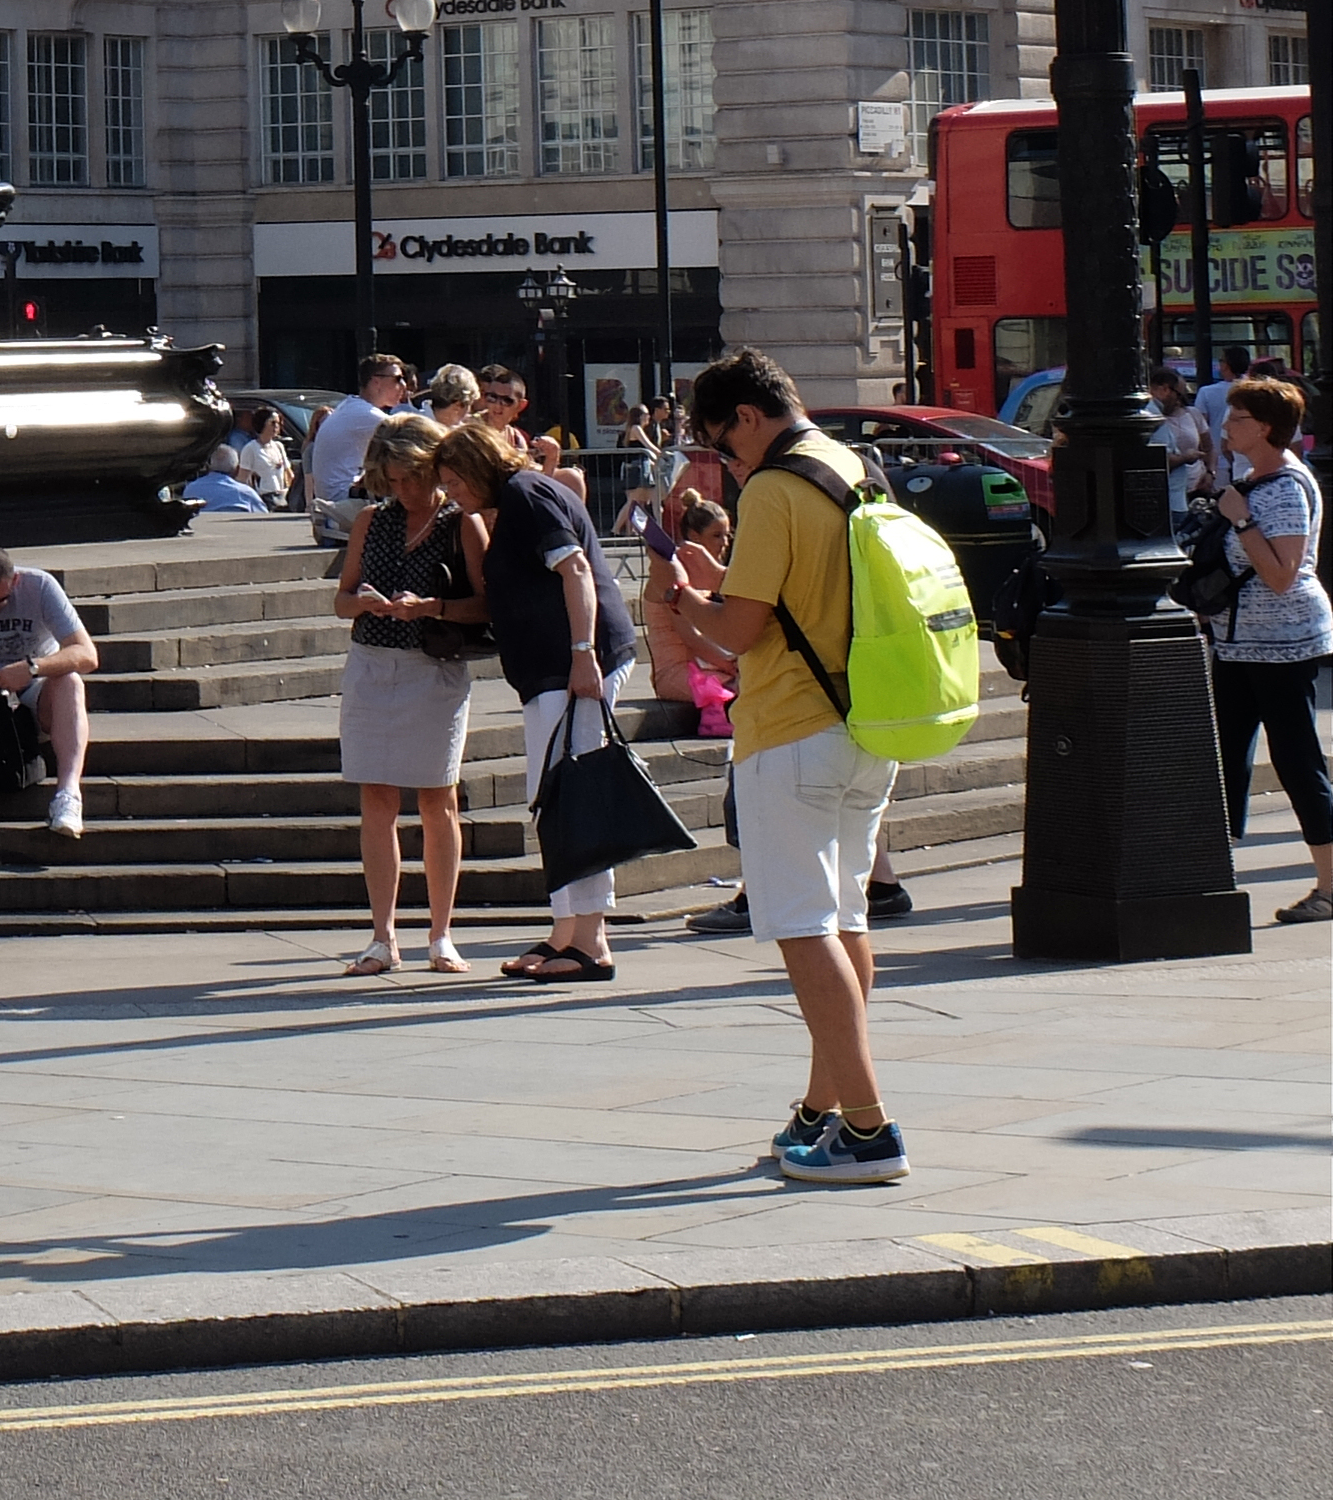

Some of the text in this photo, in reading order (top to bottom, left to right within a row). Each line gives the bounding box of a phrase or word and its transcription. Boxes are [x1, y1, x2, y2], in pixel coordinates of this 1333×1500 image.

[400, 230, 595, 263] Clydesdale Bank
[1160, 255, 1269, 294] SUCIDE
